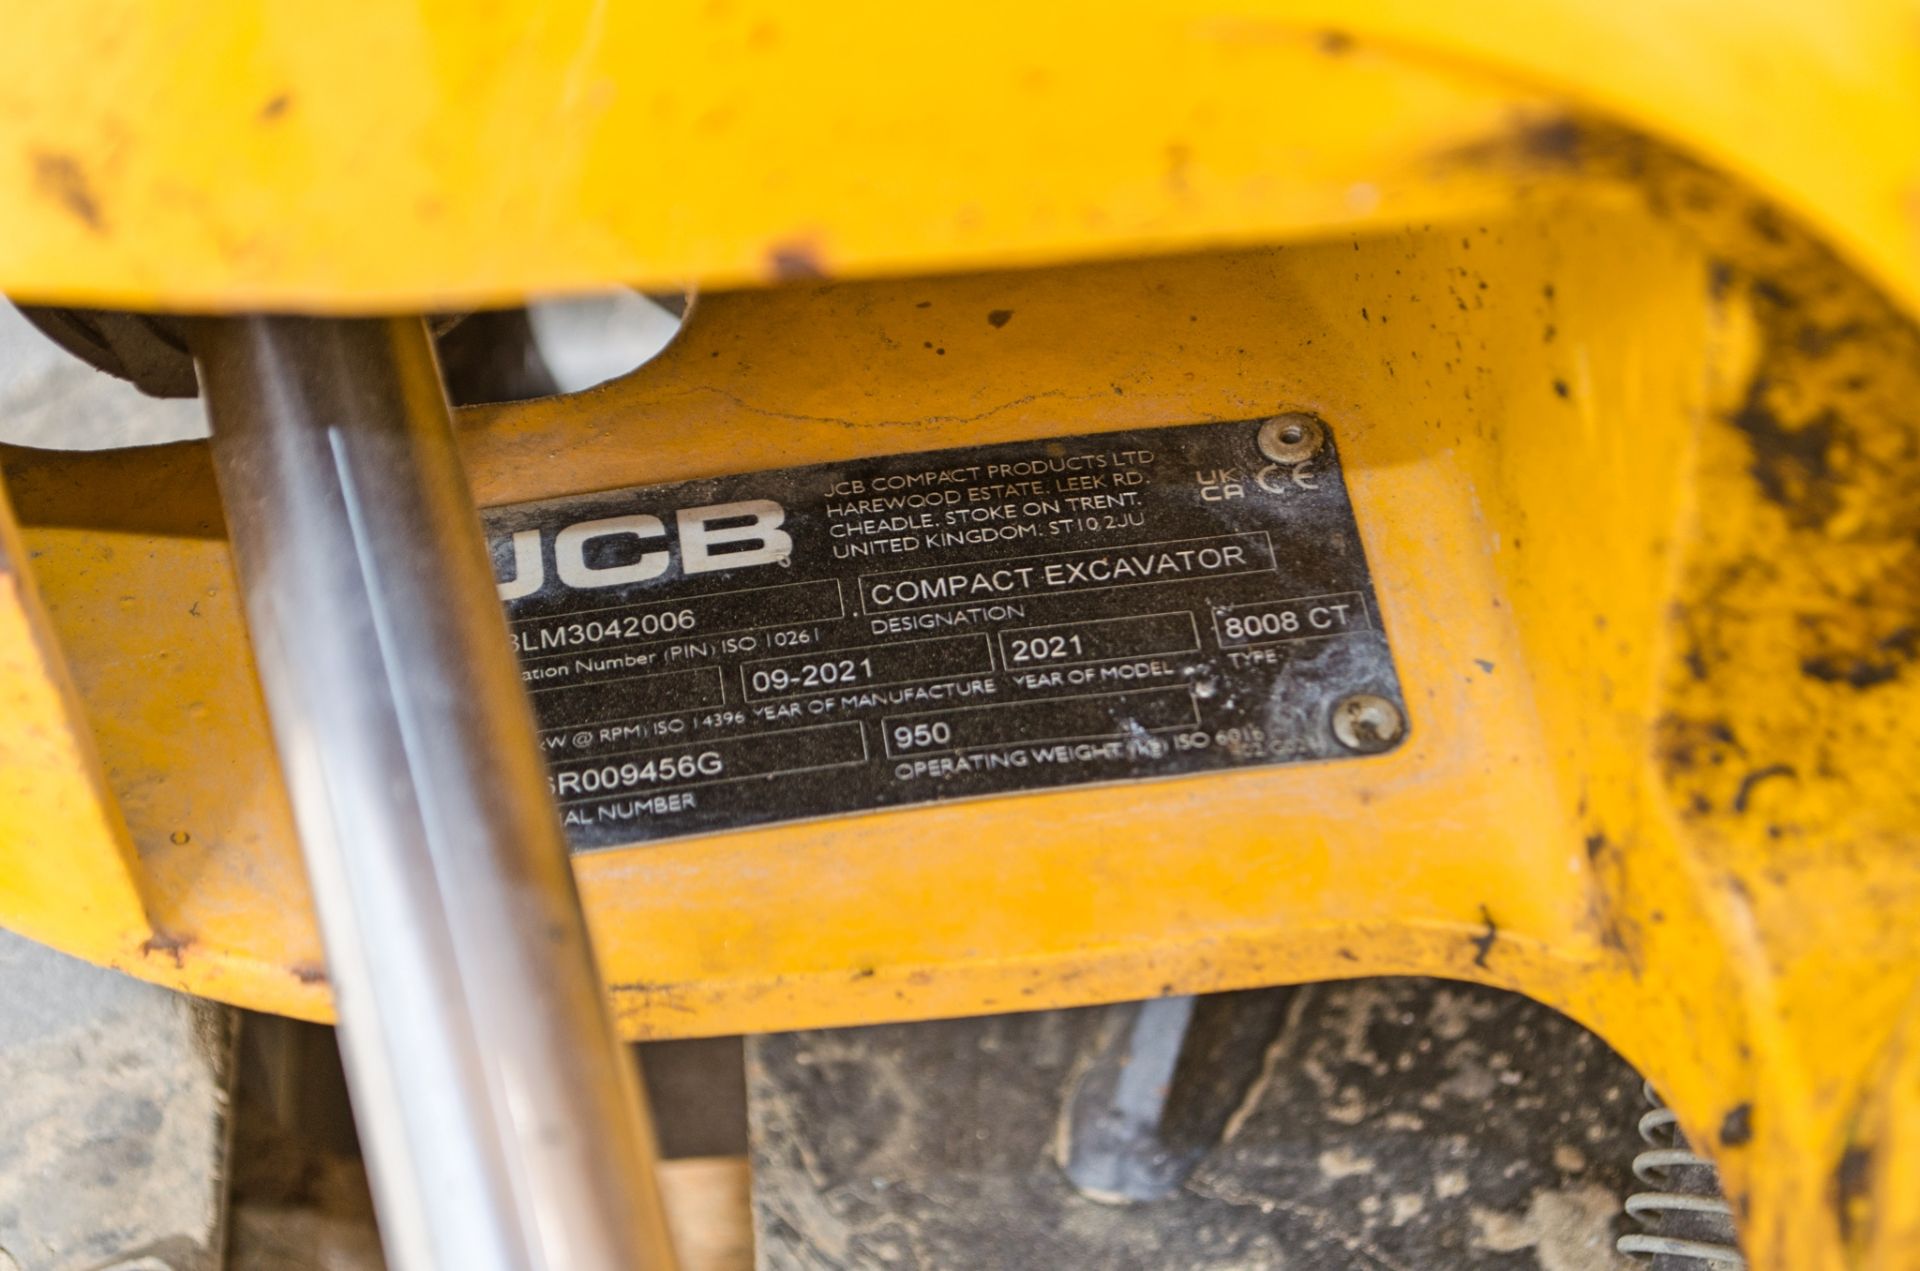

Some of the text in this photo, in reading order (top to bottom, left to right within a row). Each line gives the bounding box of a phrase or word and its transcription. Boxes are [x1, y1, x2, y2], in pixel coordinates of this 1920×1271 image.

[824, 450, 1155, 498] JCB COMPACT PRODUCTS LTD
[1196, 468, 1237, 485] UK
[826, 491, 961, 518] HAREWOOD
[1055, 475, 1106, 493] LEEK
[1200, 484, 1245, 501] CA
[946, 503, 1017, 525] STOKE
[1022, 499, 1060, 516] ON
[498, 499, 793, 600] JCB
[833, 536, 920, 559] UNITED
[1105, 511, 1146, 529] 2JU
[871, 545, 1247, 605] COMPACT EXCAVATOR
[871, 603, 1026, 635] DESIGNATION
[1225, 604, 1350, 639] 8008 CT
[575, 654, 656, 674] Number
[722, 636, 757, 655] ISO
[766, 627, 820, 648] 10261
[1011, 634, 1084, 662] 2021
[1227, 649, 1277, 668] TYPE
[752, 657, 874, 693] 09-2021
[1013, 660, 1175, 689] YEAR OF MODEL
[753, 678, 997, 721] YEAR OF MANUFACTURE
[572, 731, 593, 749] @
[653, 719, 685, 736] ISO
[692, 711, 745, 730] 14396
[894, 721, 951, 749] 950
[895, 750, 1028, 781] OPERATING
[1032, 741, 1122, 763] WEIGHT
[1172, 731, 1210, 749] ISO
[598, 793, 696, 821] NUMBER
